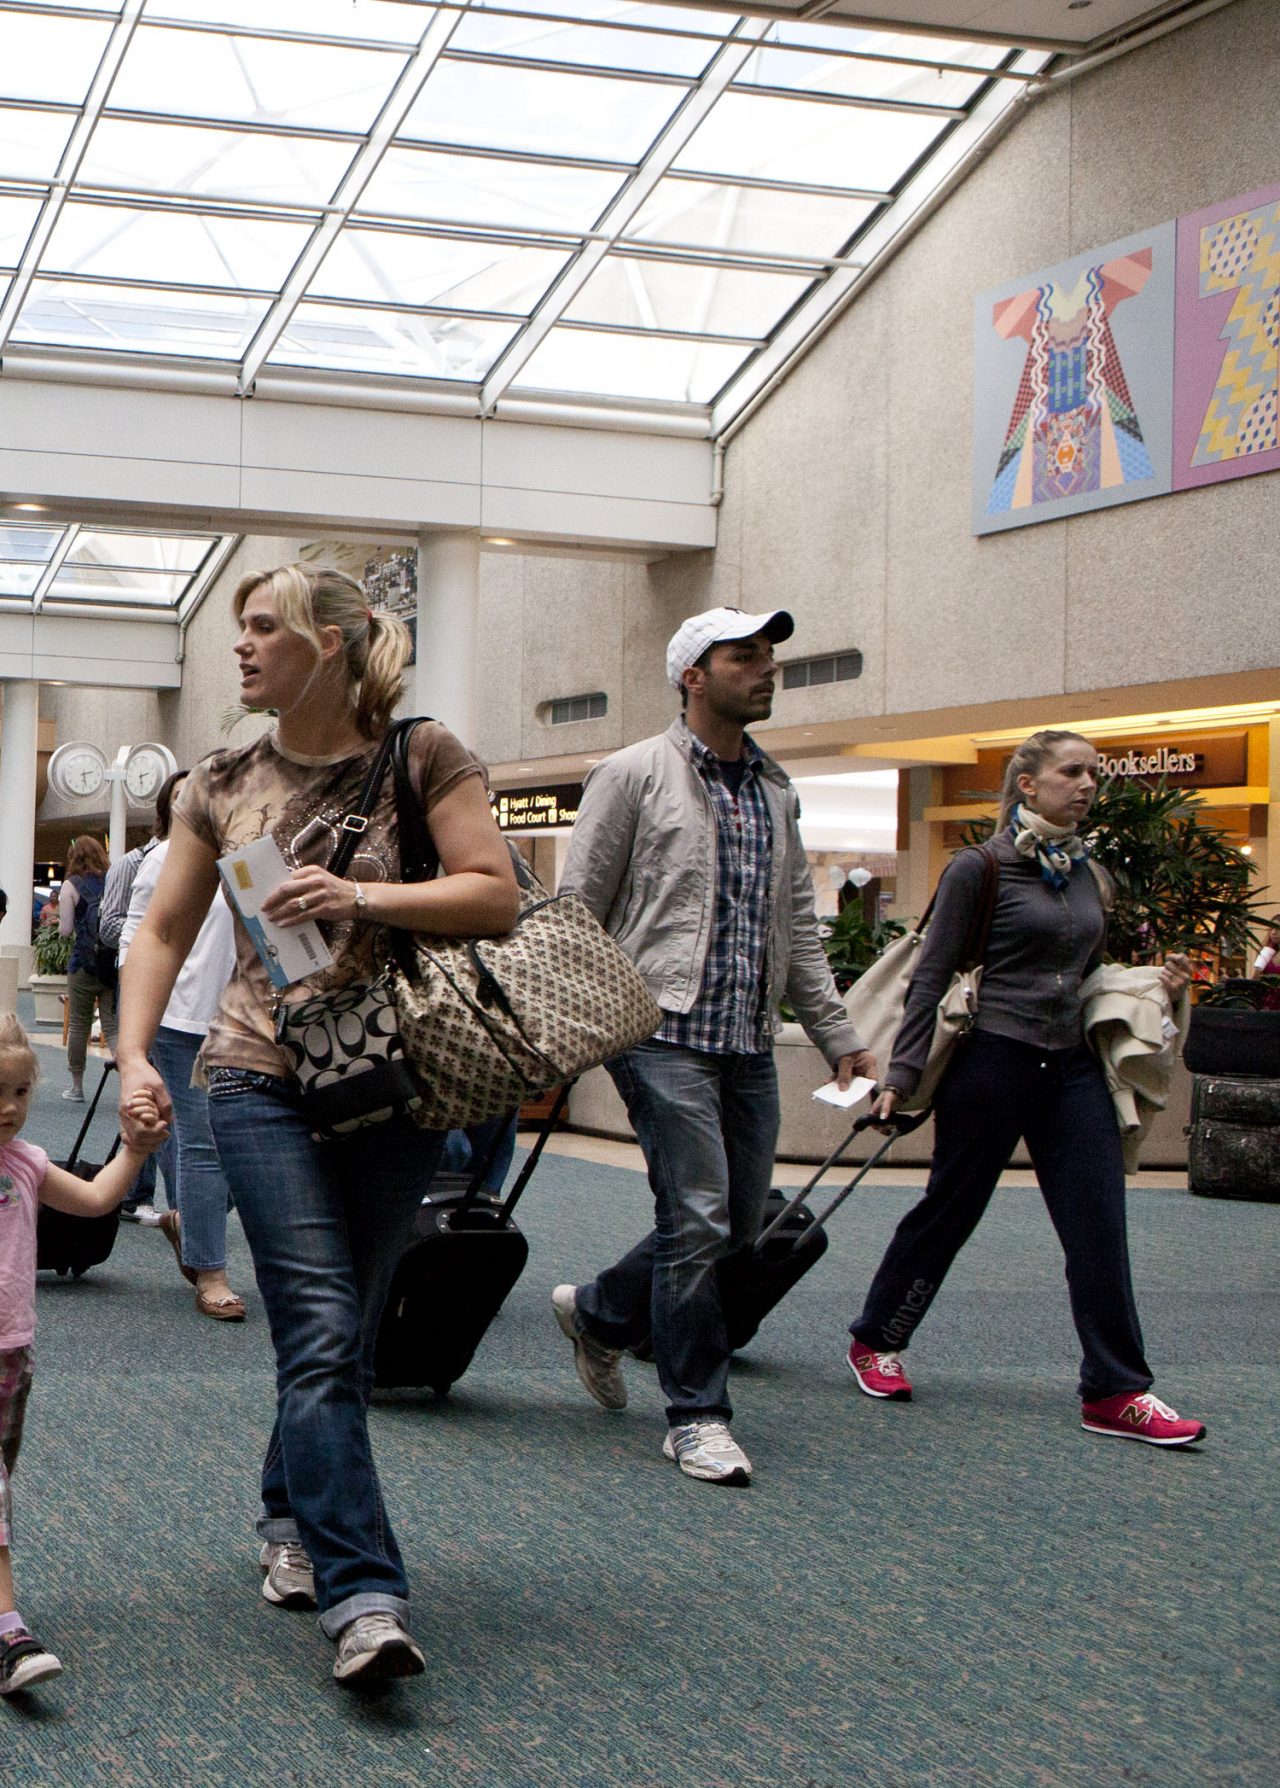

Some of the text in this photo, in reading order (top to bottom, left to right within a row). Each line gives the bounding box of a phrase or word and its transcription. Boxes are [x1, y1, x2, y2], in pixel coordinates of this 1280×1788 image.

[1097, 747, 1196, 776] Booksellers
[510, 797, 529, 812] Hyatt
[535, 794, 557, 808] Dining
[510, 812, 526, 824] Food
[527, 811, 546, 824] Court
